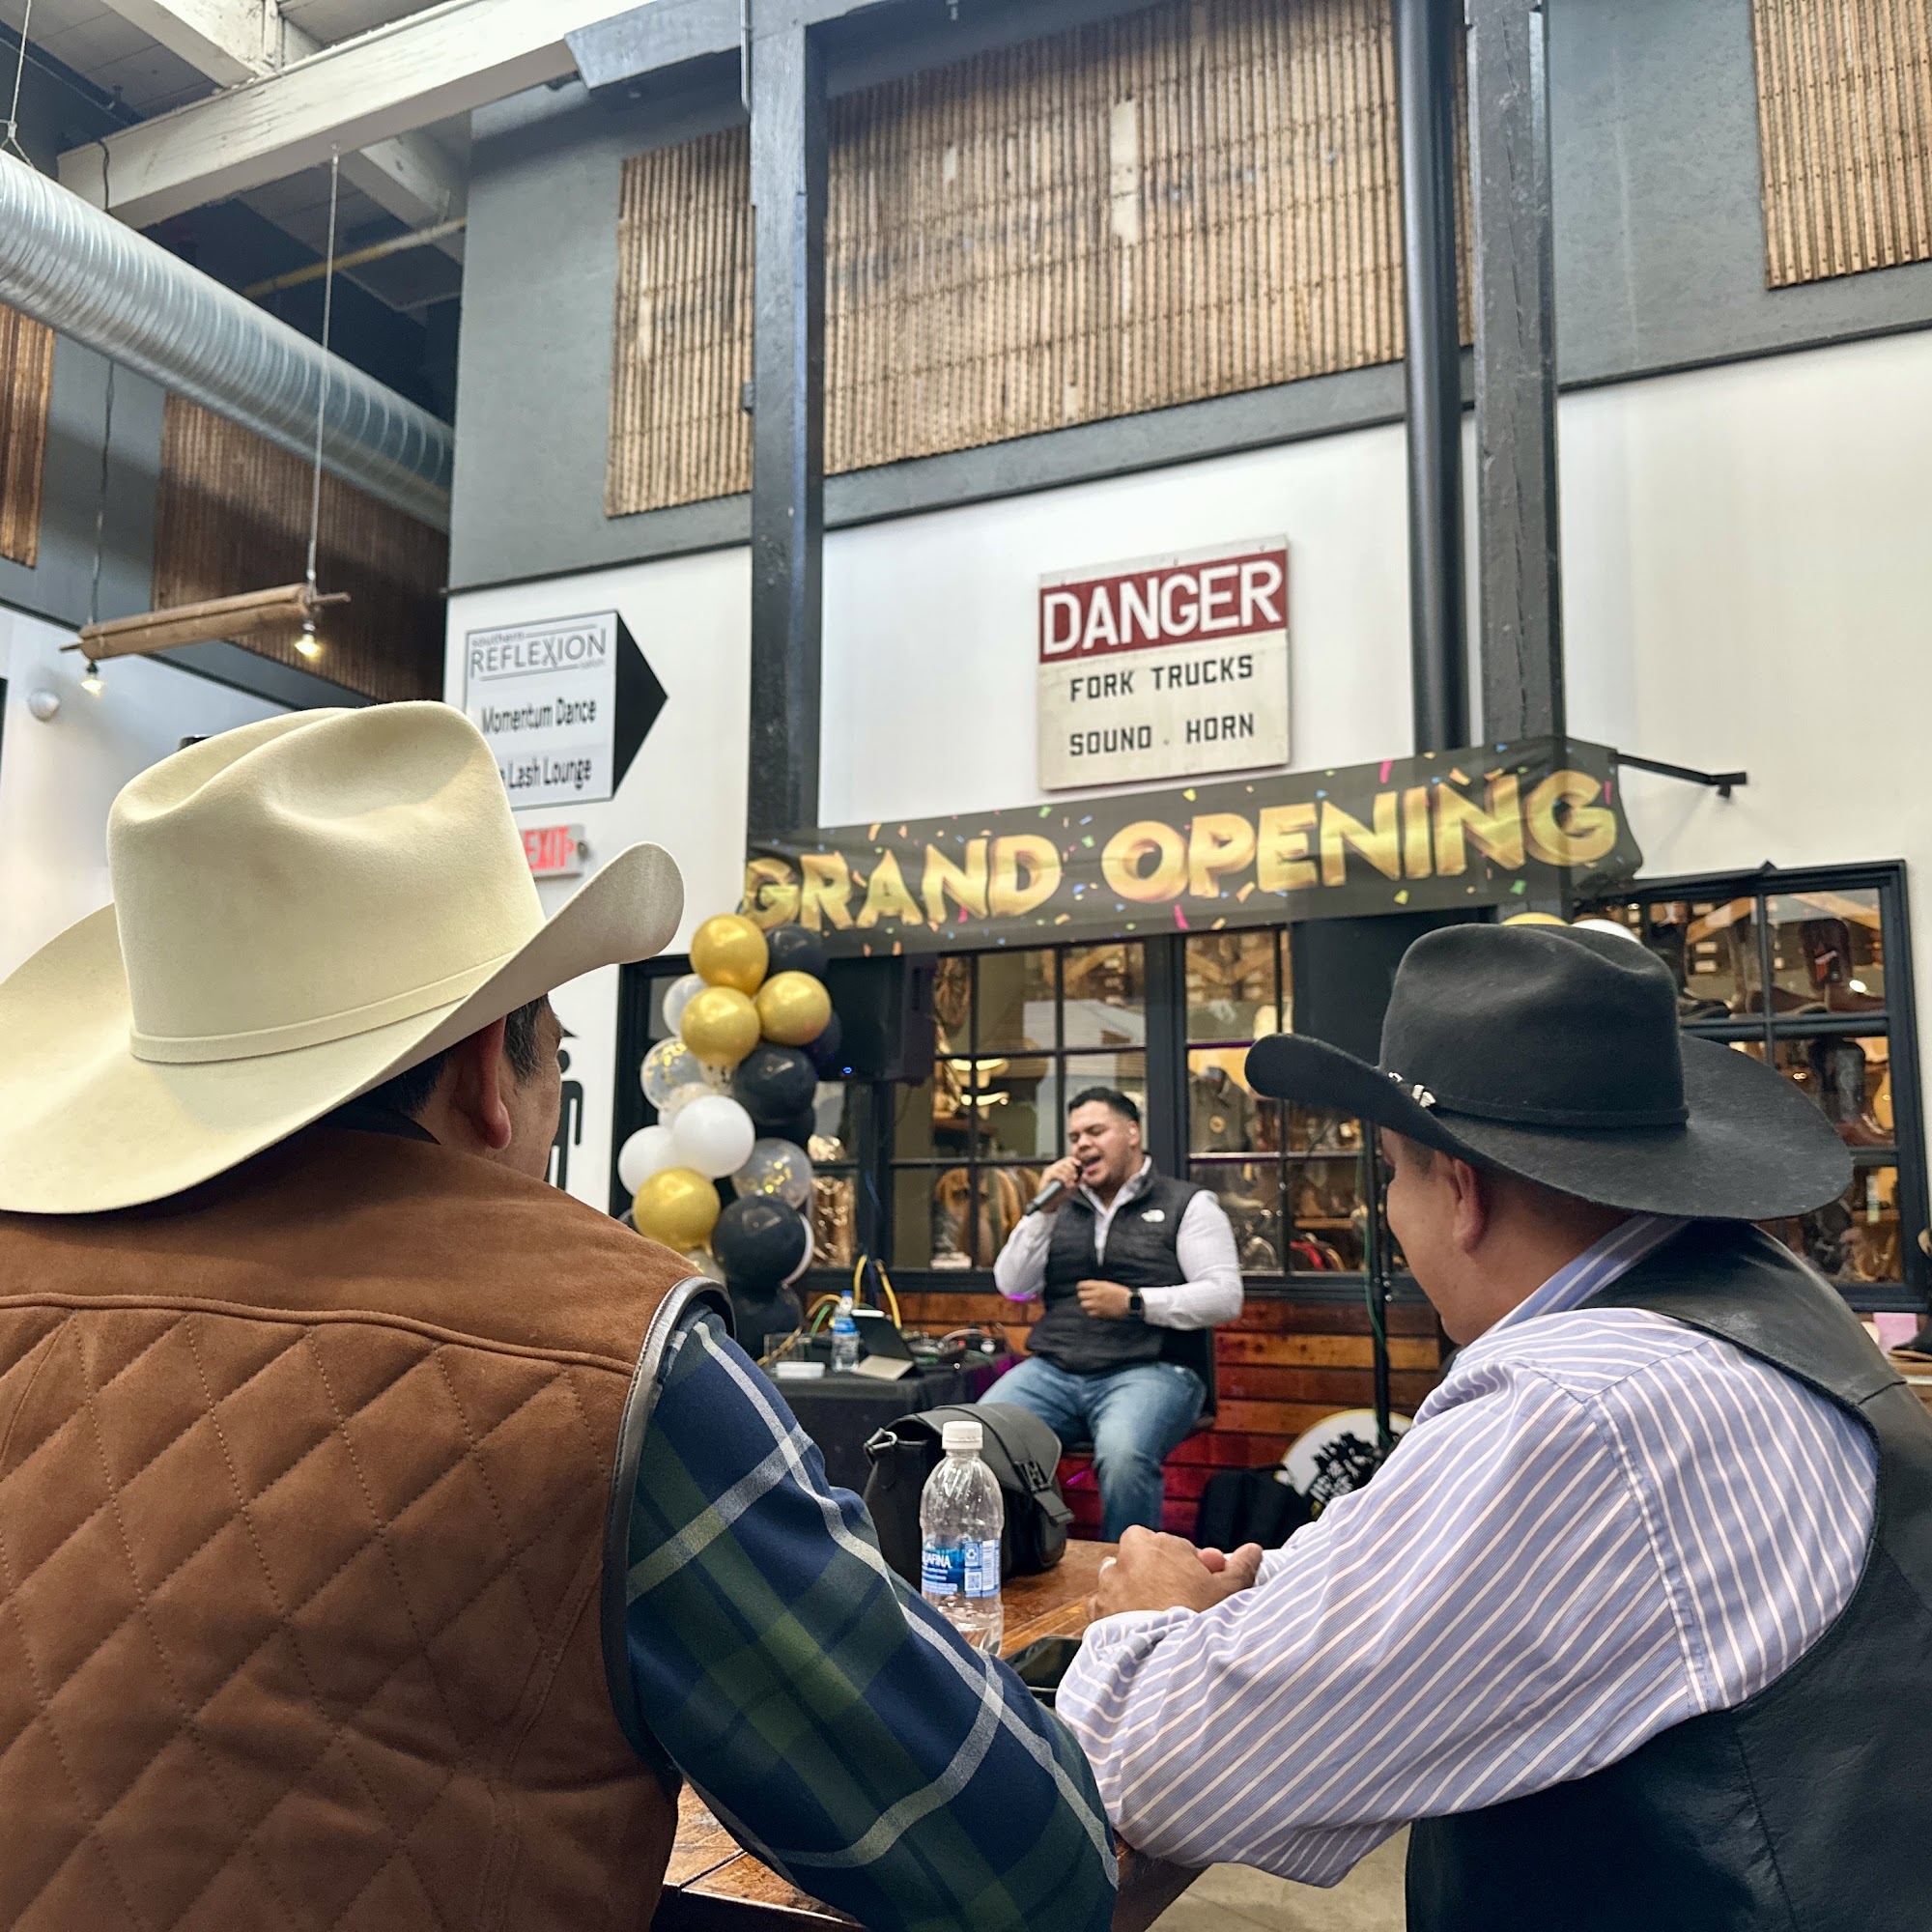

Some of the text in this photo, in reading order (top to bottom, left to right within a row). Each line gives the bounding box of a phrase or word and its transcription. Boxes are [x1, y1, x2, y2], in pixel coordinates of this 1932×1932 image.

[1042, 559, 1283, 656] DANGER
[469, 628, 607, 679] REFLEXION
[1069, 654, 1254, 702] FORK TRUCKS
[482, 696, 597, 734] Momentum Dance
[1069, 712, 1255, 756] SOUND HORN
[507, 755, 540, 789] Lash
[543, 755, 592, 791] Lounge
[523, 826, 570, 870] EXIT
[742, 769, 1618, 932] GRAND OPENING
